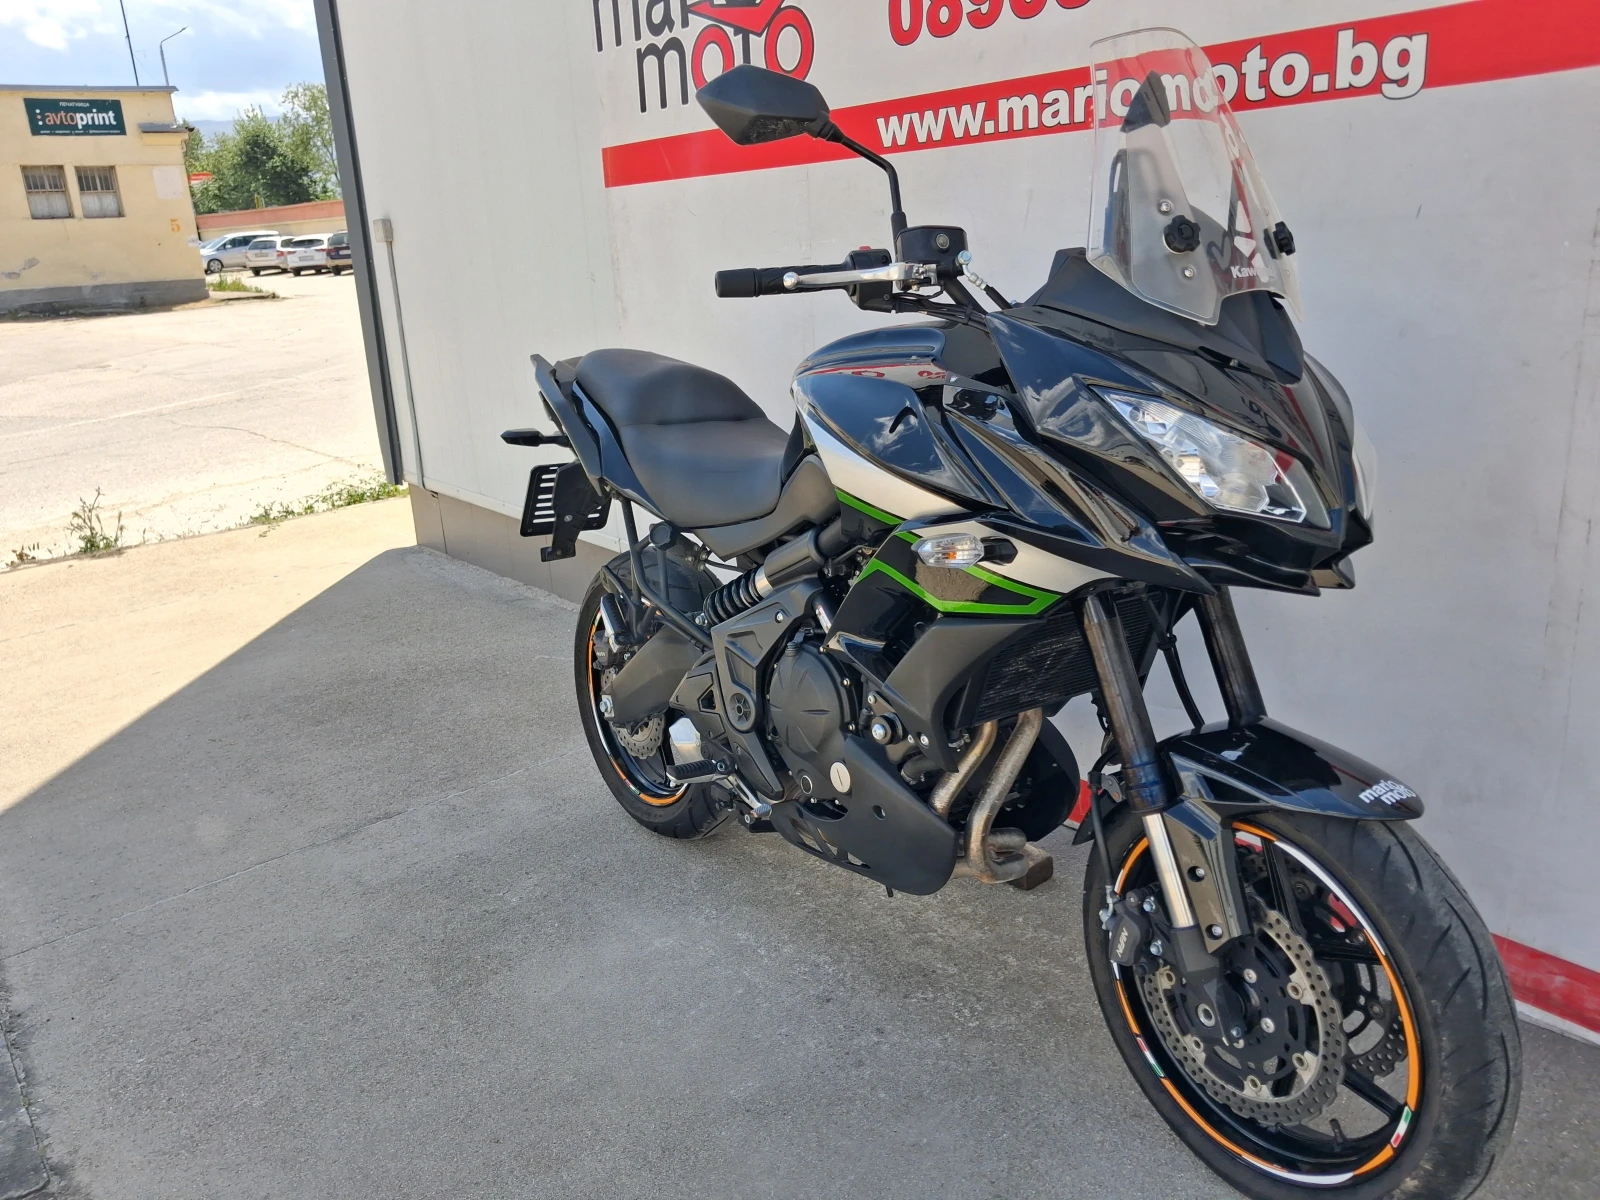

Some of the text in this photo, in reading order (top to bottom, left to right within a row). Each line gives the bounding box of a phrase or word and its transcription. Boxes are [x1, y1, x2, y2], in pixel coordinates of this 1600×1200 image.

[877, 28, 1429, 148] www.mariomoto.bg
[45, 108, 117, 129] avtoprint
[170, 218, 181, 233] 5
[1359, 780, 1401, 803] mario
[1380, 784, 1416, 805] moto
